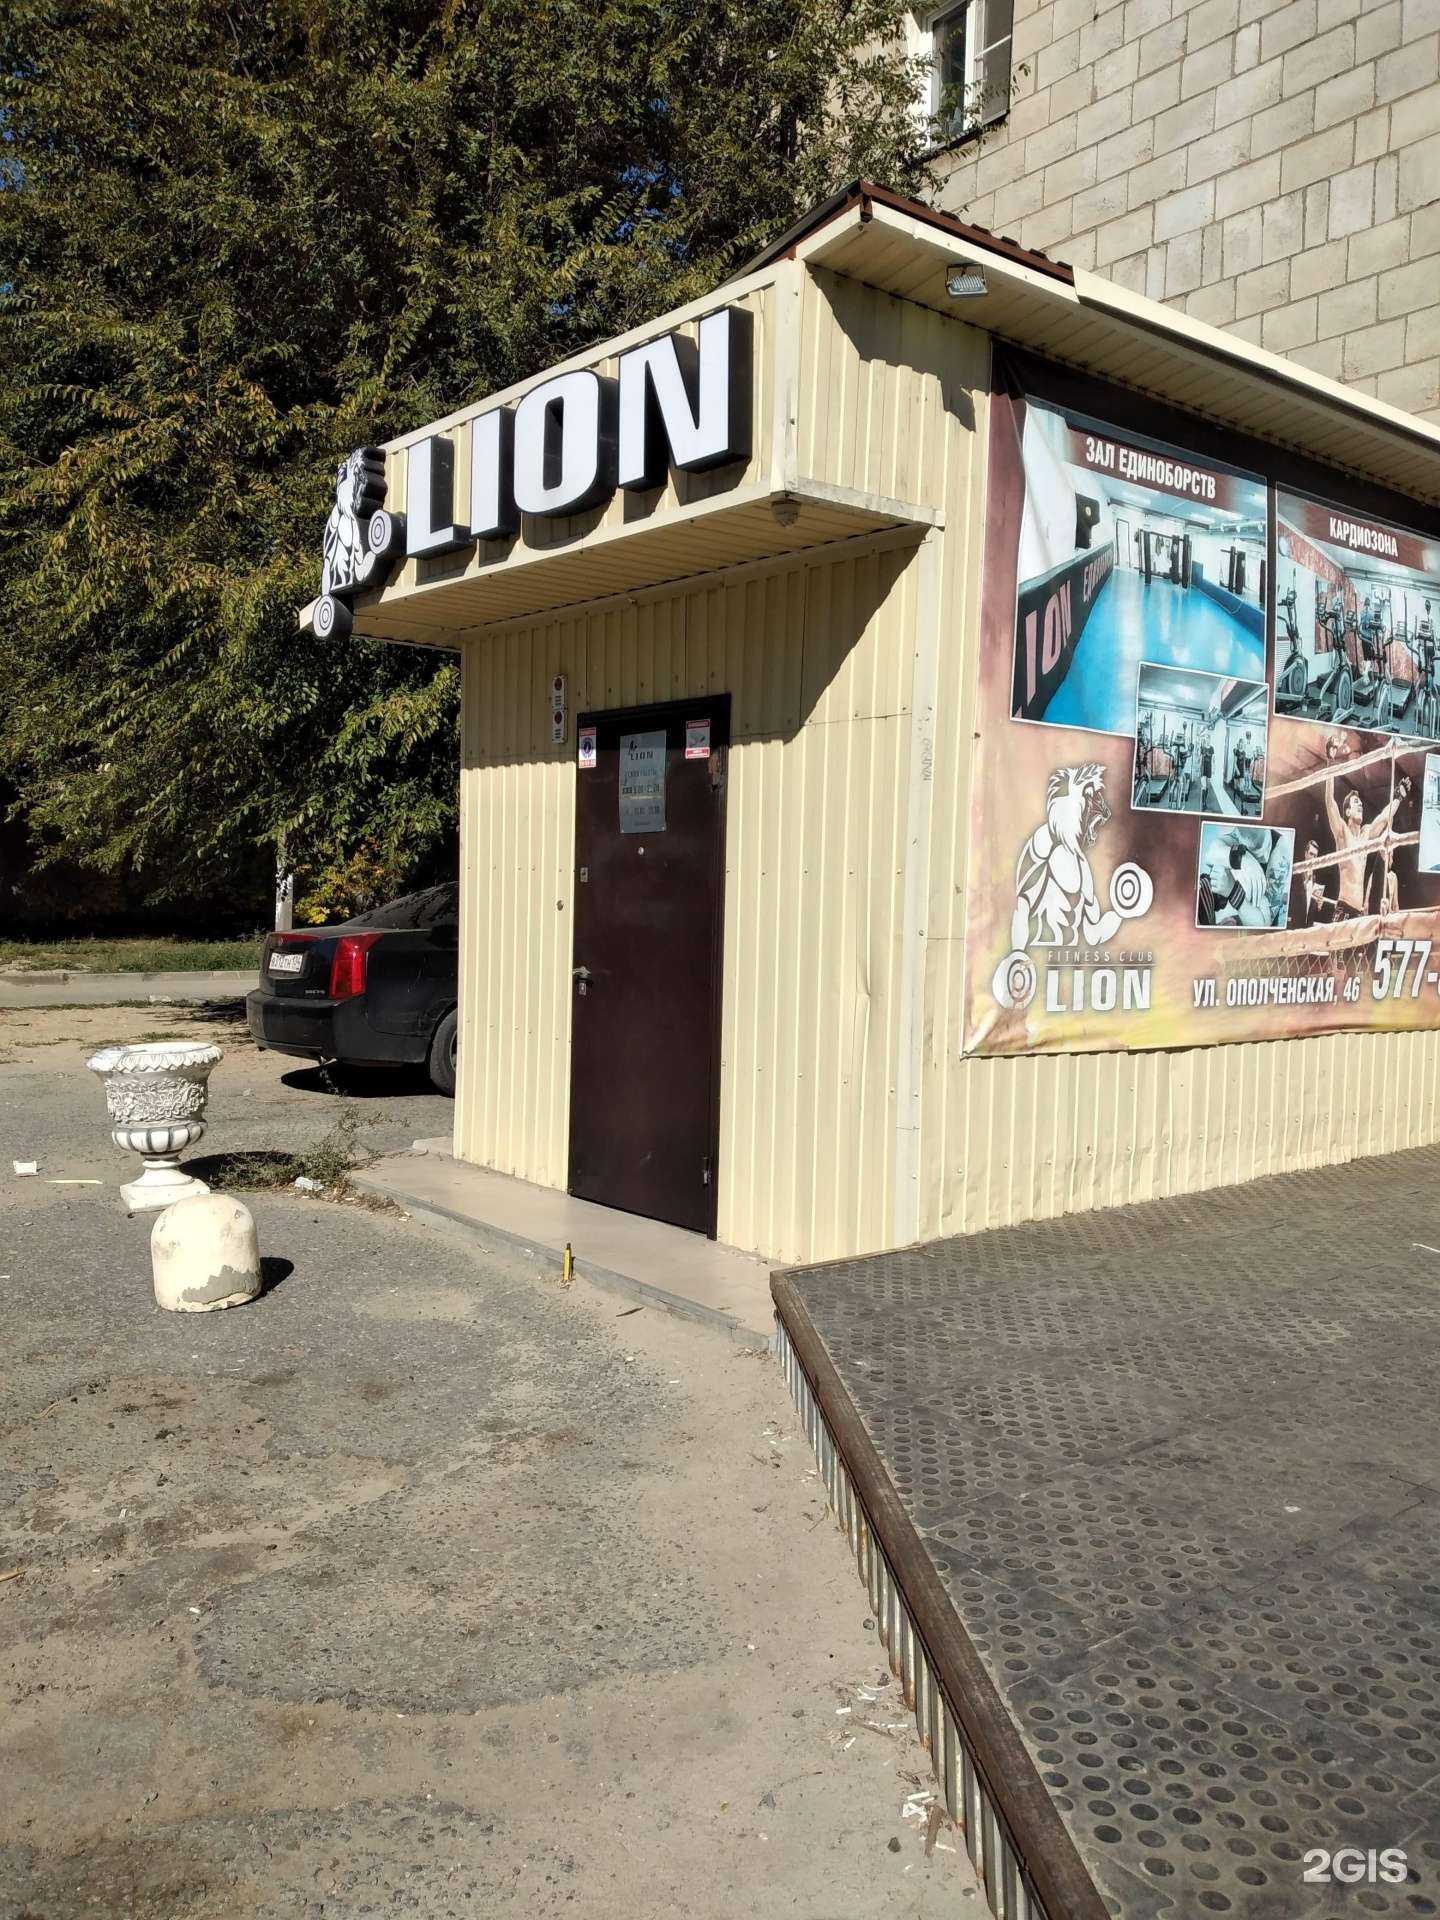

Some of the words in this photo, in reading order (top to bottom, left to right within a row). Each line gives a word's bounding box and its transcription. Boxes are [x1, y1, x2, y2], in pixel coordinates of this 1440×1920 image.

[406, 308, 731, 558] LION
[1086, 436, 1115, 469] ЗАЛ
[1119, 447, 1216, 499] ЕДИНОБОРСТВ
[1329, 517, 1398, 557] КАРДИОЗОНА
[1048, 950, 1110, 961] FITNESS
[1119, 950, 1153, 961] CLUB
[1372, 940, 1440, 1000] 577-
[1046, 969, 1151, 1012] LION
[1193, 979, 1220, 1007] УЛ.
[1226, 976, 1338, 1007] ОПОЛЧЕНСКАЯ,
[1343, 976, 1361, 1002] 46
